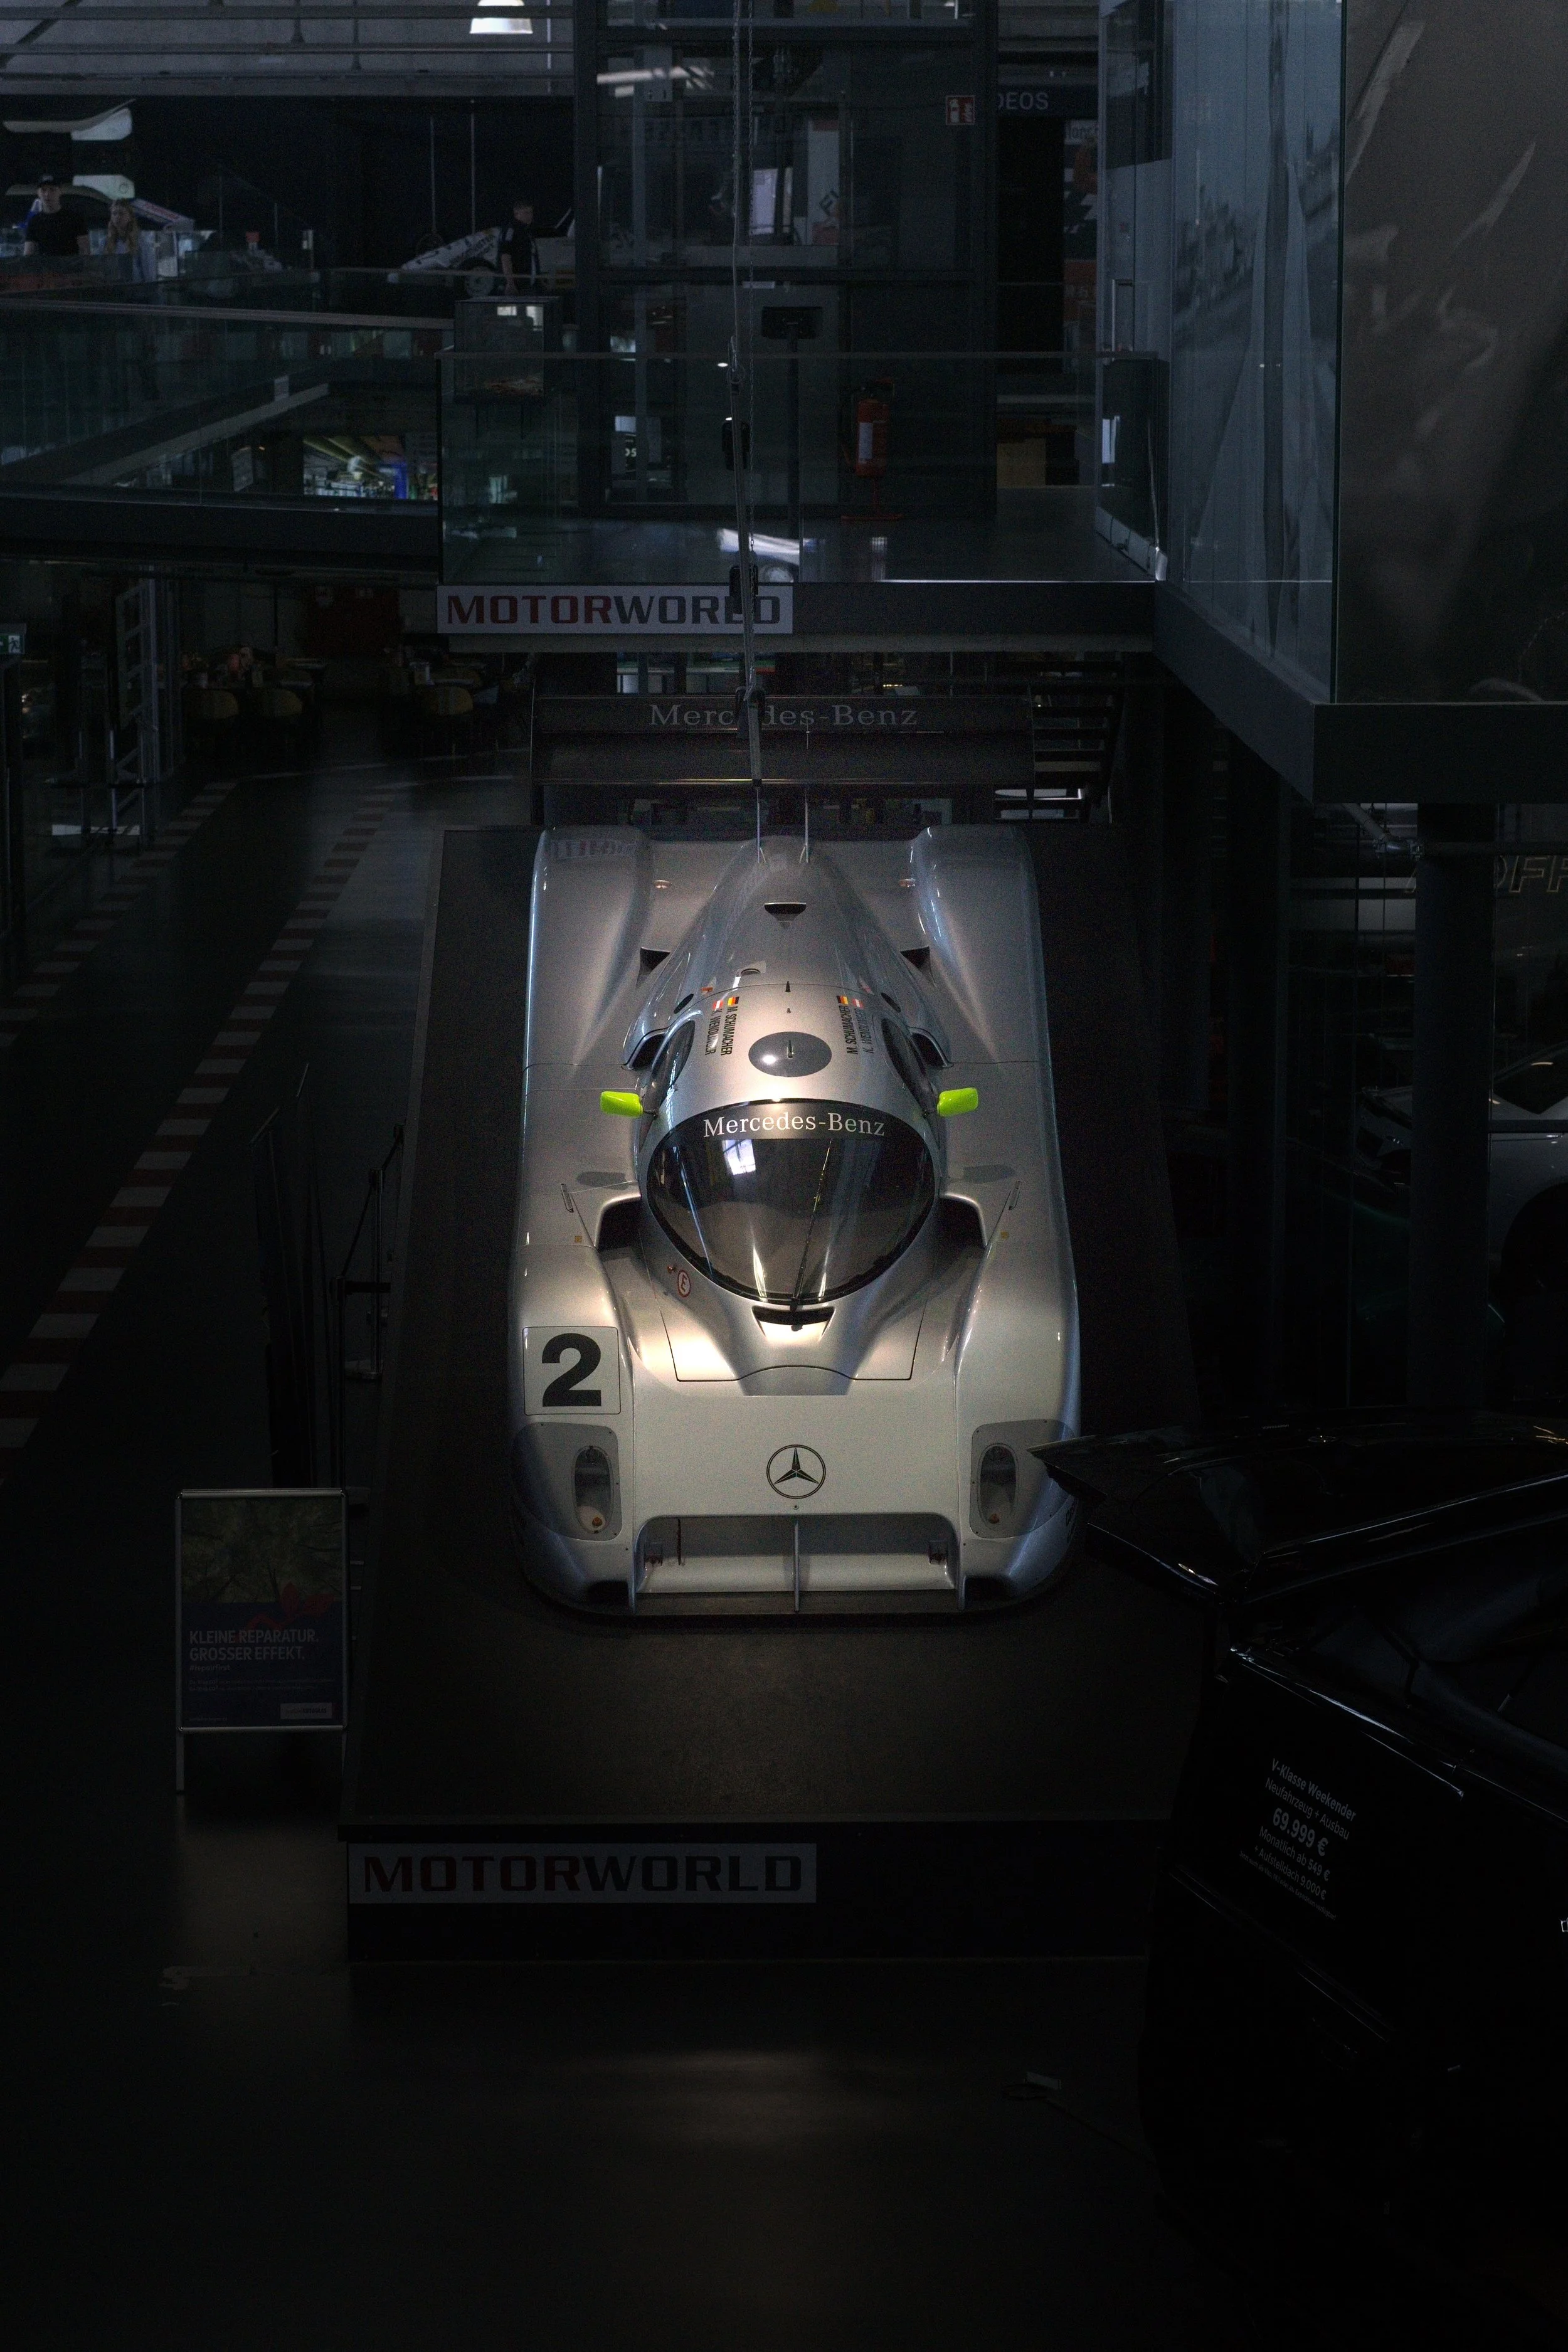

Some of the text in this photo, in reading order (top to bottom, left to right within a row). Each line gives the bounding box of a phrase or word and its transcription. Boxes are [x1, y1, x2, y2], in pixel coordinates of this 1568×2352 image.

[447, 595, 780, 625] MOTORWORLD
[649, 704, 917, 726] Mercdes-Benz
[721, 1014, 737, 1056] SCHUMACHER
[839, 1005, 857, 1044] SCHUMACHER
[703, 1112, 885, 1137] Mercedes-Benz
[542, 1333, 602, 1407] 2
[189, 1629, 319, 1644] KLEINE REPARATUR.
[189, 1646, 305, 1661] GROSSER EFFEKT.
[189, 1664, 231, 1673] #repairfirst
[1271, 1758, 1357, 1822] V-Klasse Weekender
[1264, 1777, 1314, 1820] Neufahrzeug
[1319, 1813, 1350, 1841] Ausbau
[1272, 1807, 1328, 1857] 69.999 €
[1258, 1847, 1300, 1883] Aufstelldach
[1259, 1826, 1331, 1882] Monatlich ab 549 €
[364, 1856, 802, 1892] MOTORWORLD
